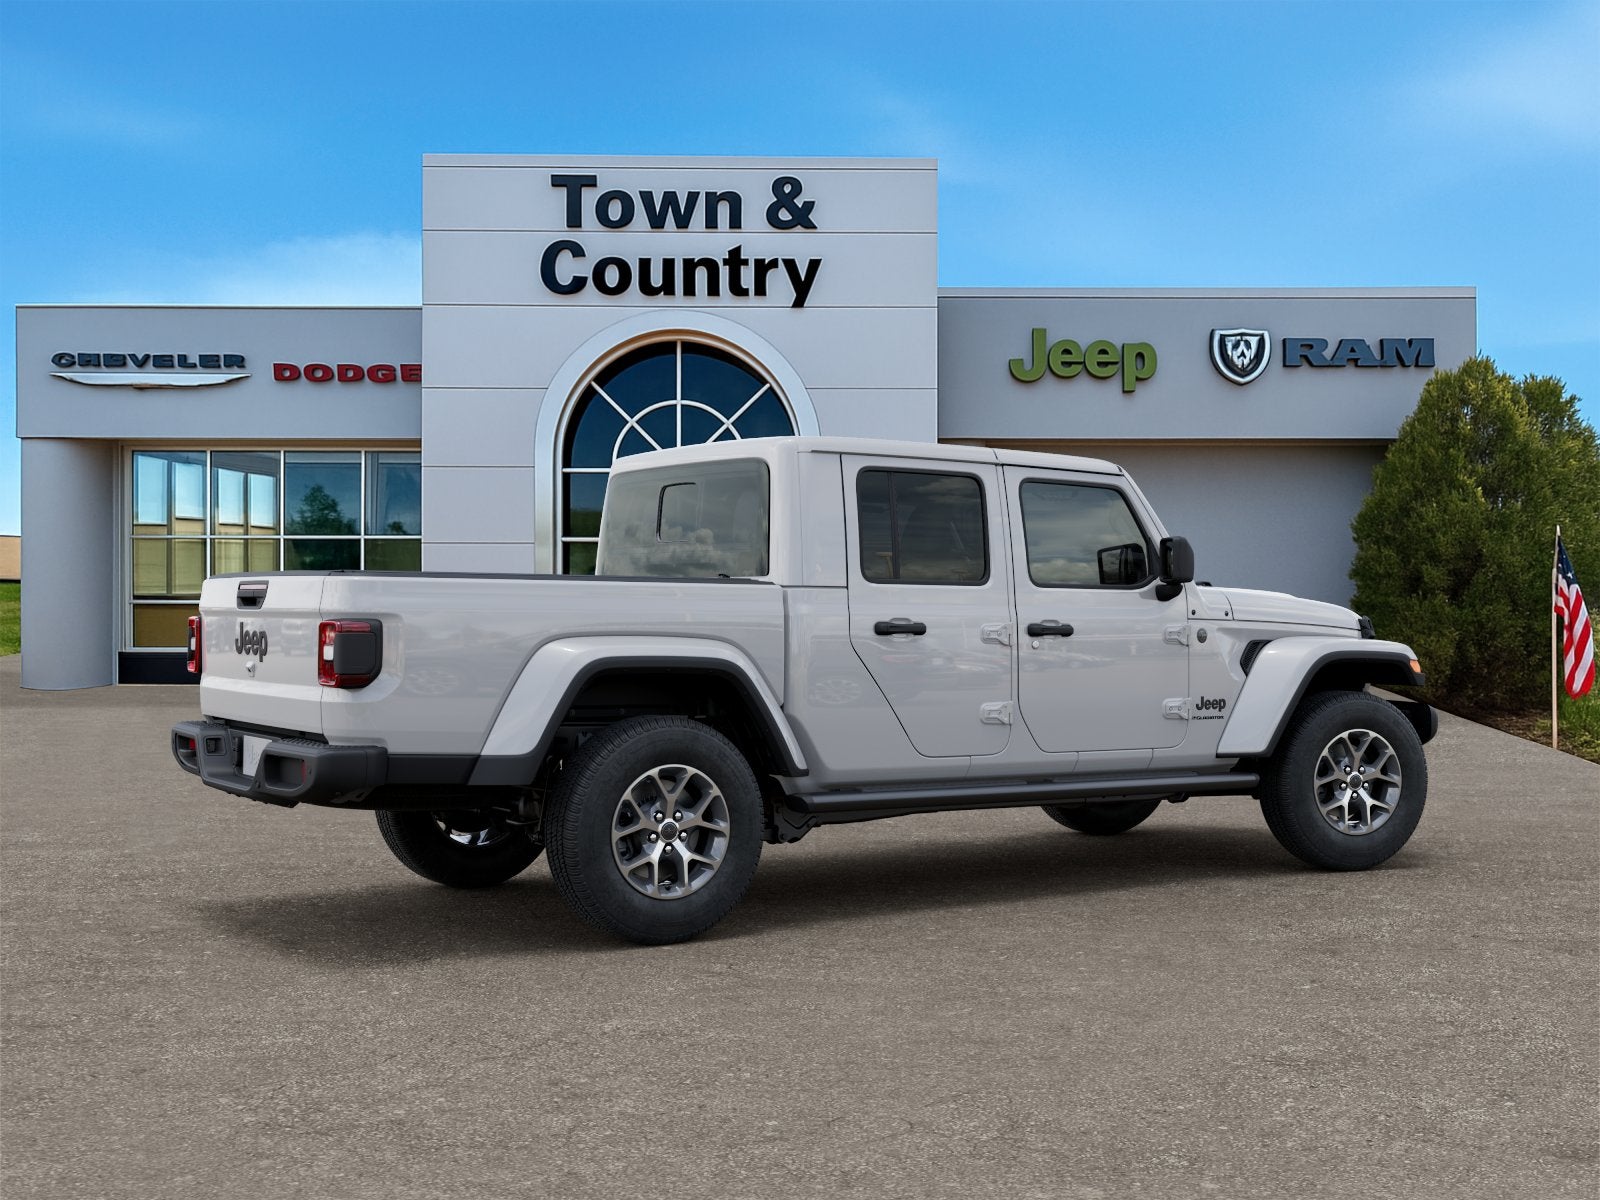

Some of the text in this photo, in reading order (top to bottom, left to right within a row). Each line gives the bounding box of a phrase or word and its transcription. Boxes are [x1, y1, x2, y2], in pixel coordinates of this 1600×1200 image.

[550, 174, 818, 230] Town &
[540, 239, 822, 308] Country
[272, 363, 422, 383] DODGE
[1009, 328, 1157, 392] Jeep
[1282, 337, 1435, 368] RAM
[235, 621, 268, 662] Jeep
[1195, 696, 1226, 712] Jeep
